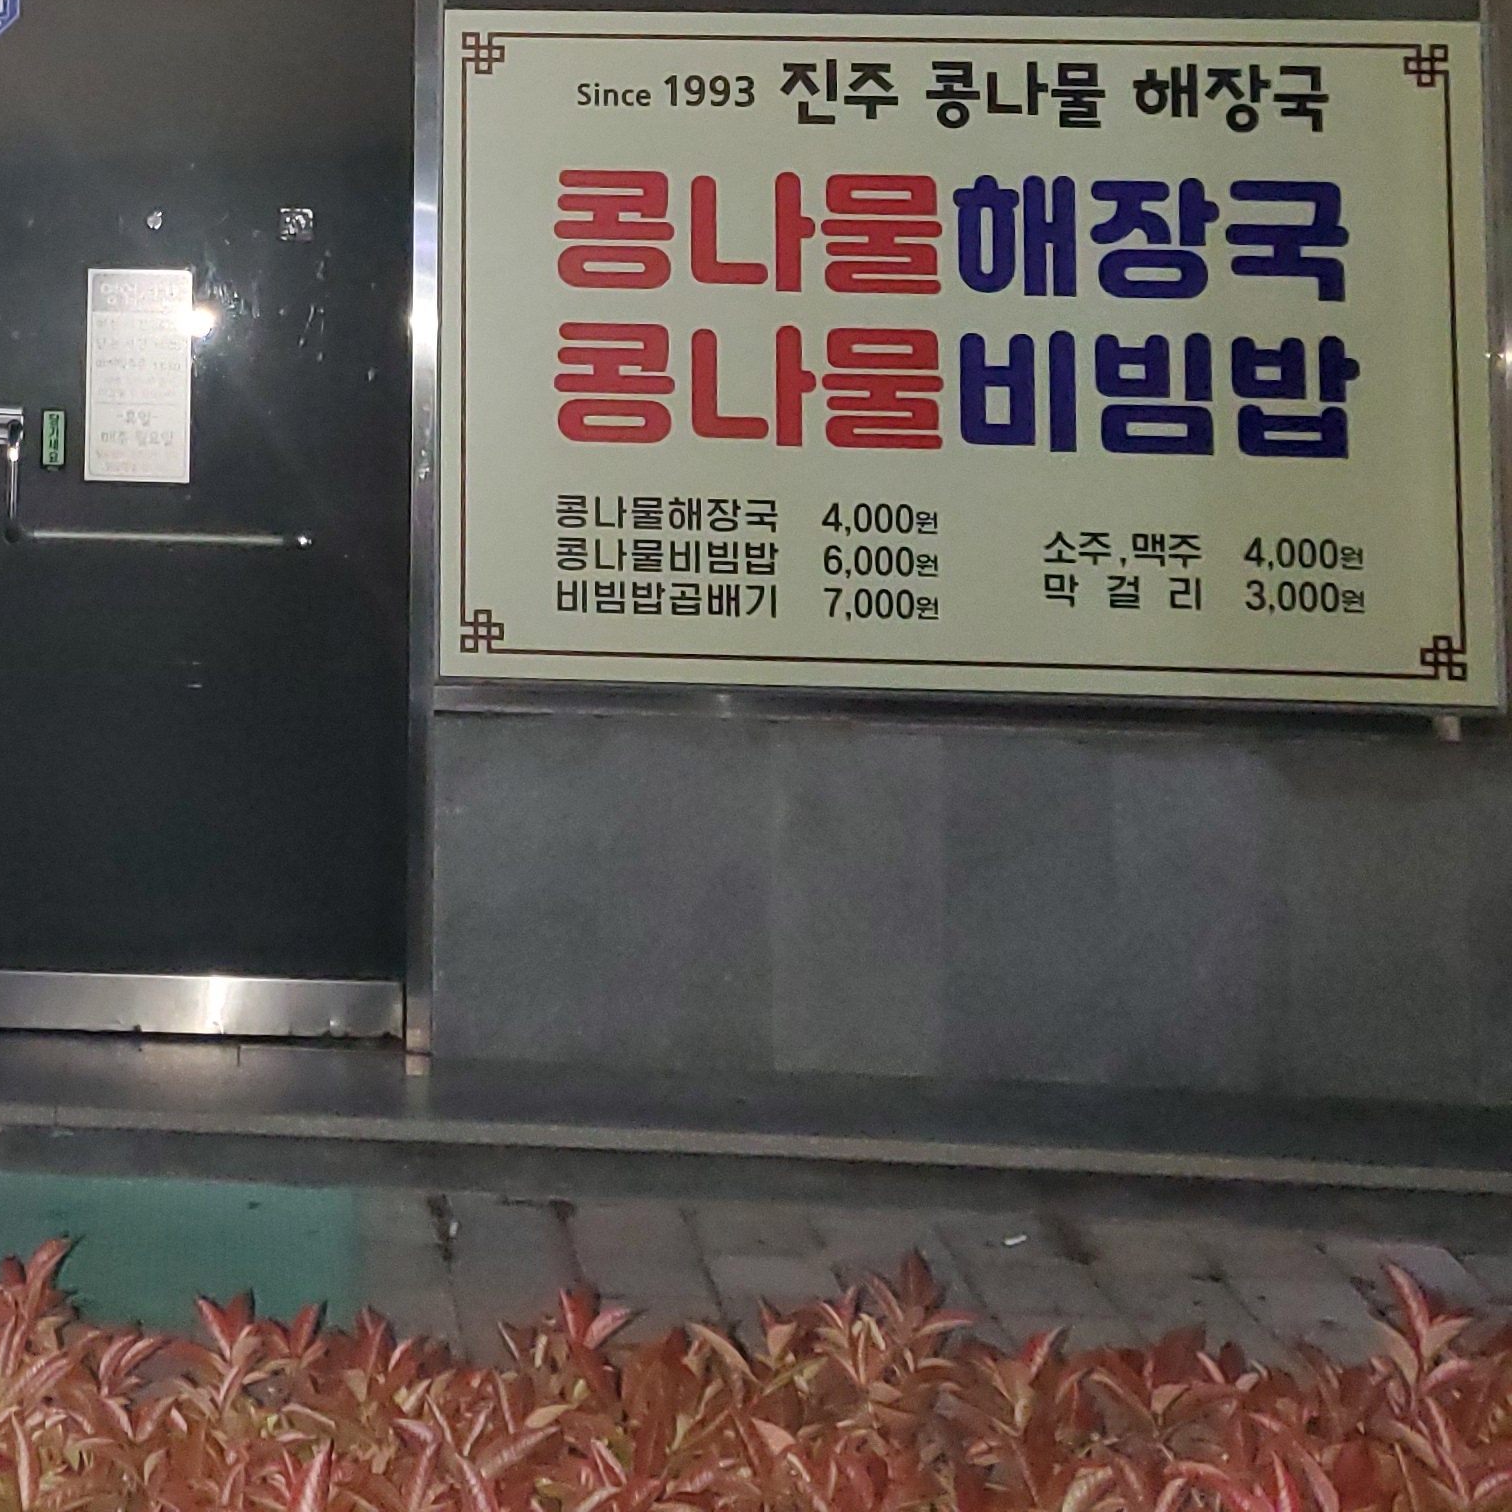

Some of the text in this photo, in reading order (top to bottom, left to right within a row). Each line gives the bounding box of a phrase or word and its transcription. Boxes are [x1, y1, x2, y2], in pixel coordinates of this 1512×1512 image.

[577, 58, 1330, 133] Since 1993 진주 콩나물 해장국
[553, 169, 1350, 303] 콩나물해장국
[554, 322, 1361, 460] 콩나물비빔밥
[556, 494, 938, 537] 콩나물해장국 4,000원
[556, 537, 939, 579] 콩나물비빔밥 6,000원
[1043, 531, 1364, 571] 소주,맥주 4,000원
[557, 579, 939, 621] 비빔밥곱배기 7,000원
[1245, 579, 1366, 614] 3,000원
